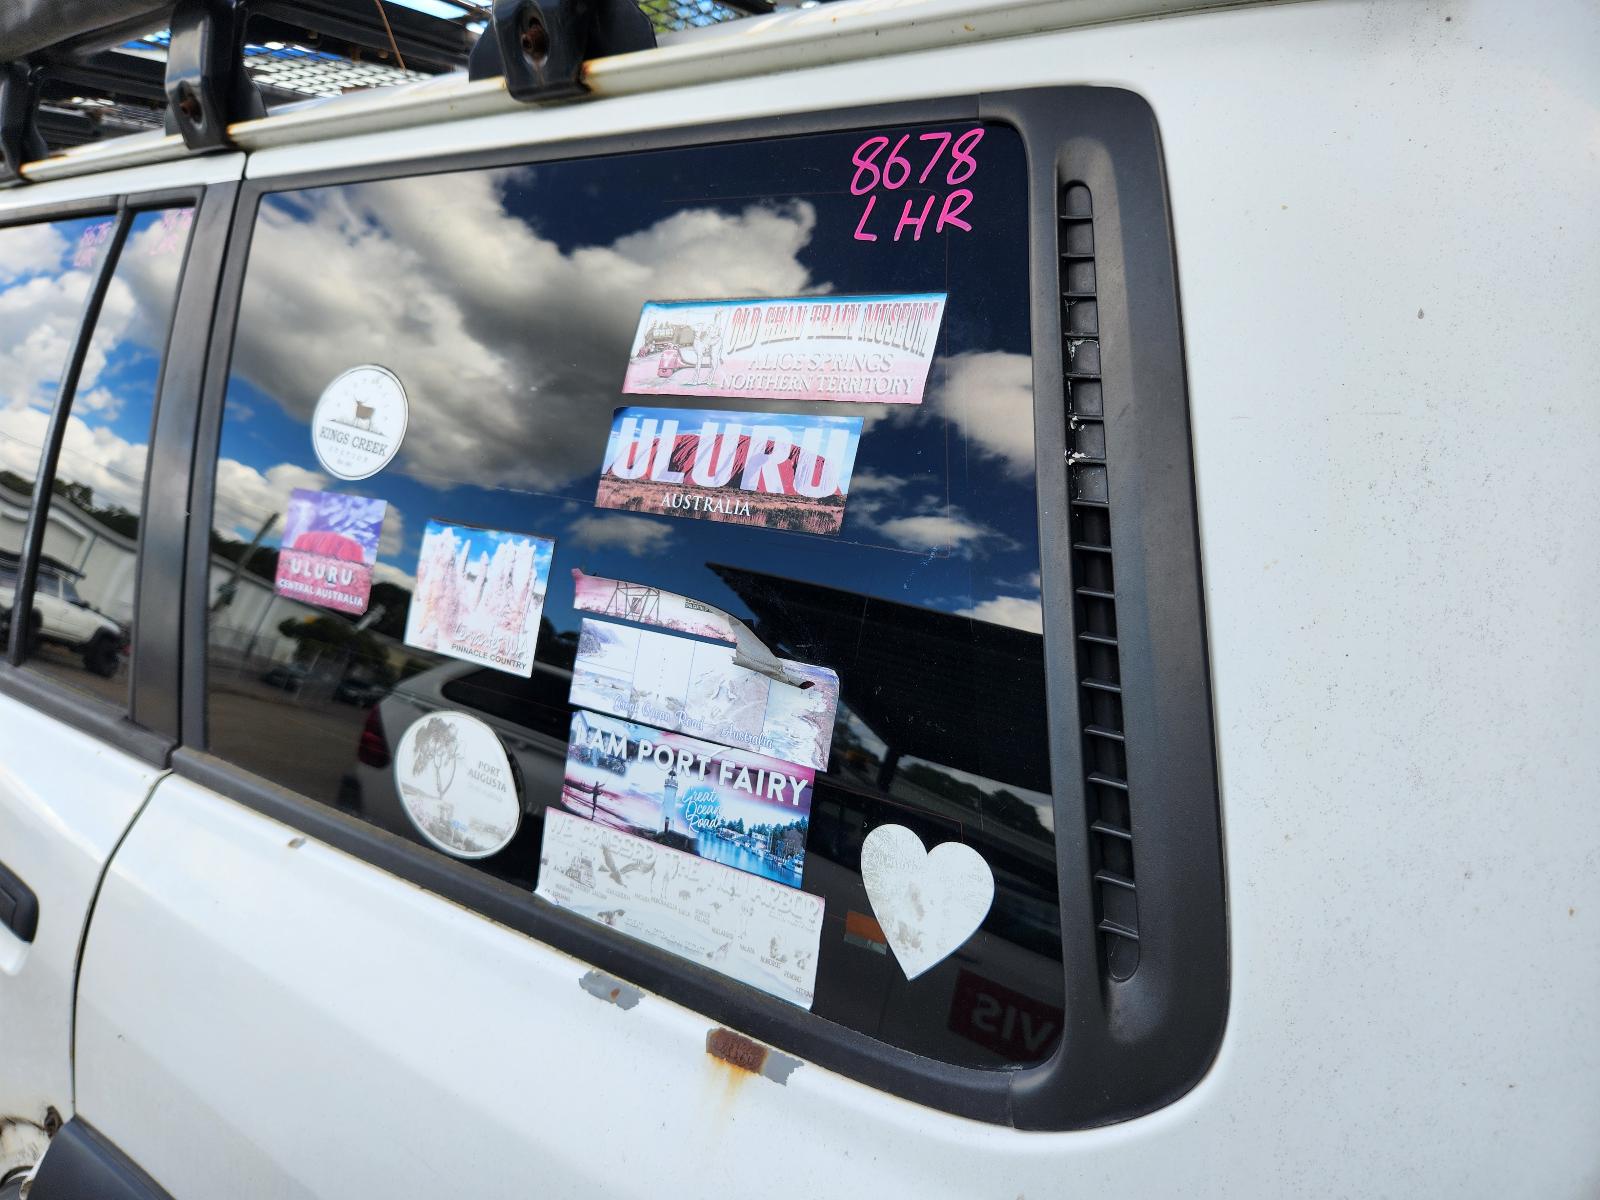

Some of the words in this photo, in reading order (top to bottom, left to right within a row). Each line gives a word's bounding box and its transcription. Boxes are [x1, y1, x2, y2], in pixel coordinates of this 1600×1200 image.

[851, 128, 985, 195] 8678
[858, 302, 939, 357] MUSEUM
[747, 352, 806, 372] ALICE
[806, 352, 895, 373] SPRINGS
[719, 373, 810, 393] NORTHERN
[815, 375, 914, 396] TERRITORY
[319, 426, 350, 446] KINGS
[351, 436, 389, 457] CREEK
[611, 417, 850, 498] ULURU
[661, 494, 751, 516] AUSTRALIA
[290, 557, 352, 584] ULURU
[279, 580, 316, 598] CENTRAL
[315, 585, 364, 608] AUSTRALIA
[450, 643, 488, 659] PINNACLE
[489, 654, 527, 670] COUNTRY
[468, 768, 507, 792] AUGUSTA
[479, 760, 503, 777] PORT
[589, 728, 628, 760] AM
[637, 742, 712, 781] PORT
[718, 760, 809, 806] FAIRY
[688, 813, 719, 832] Road
